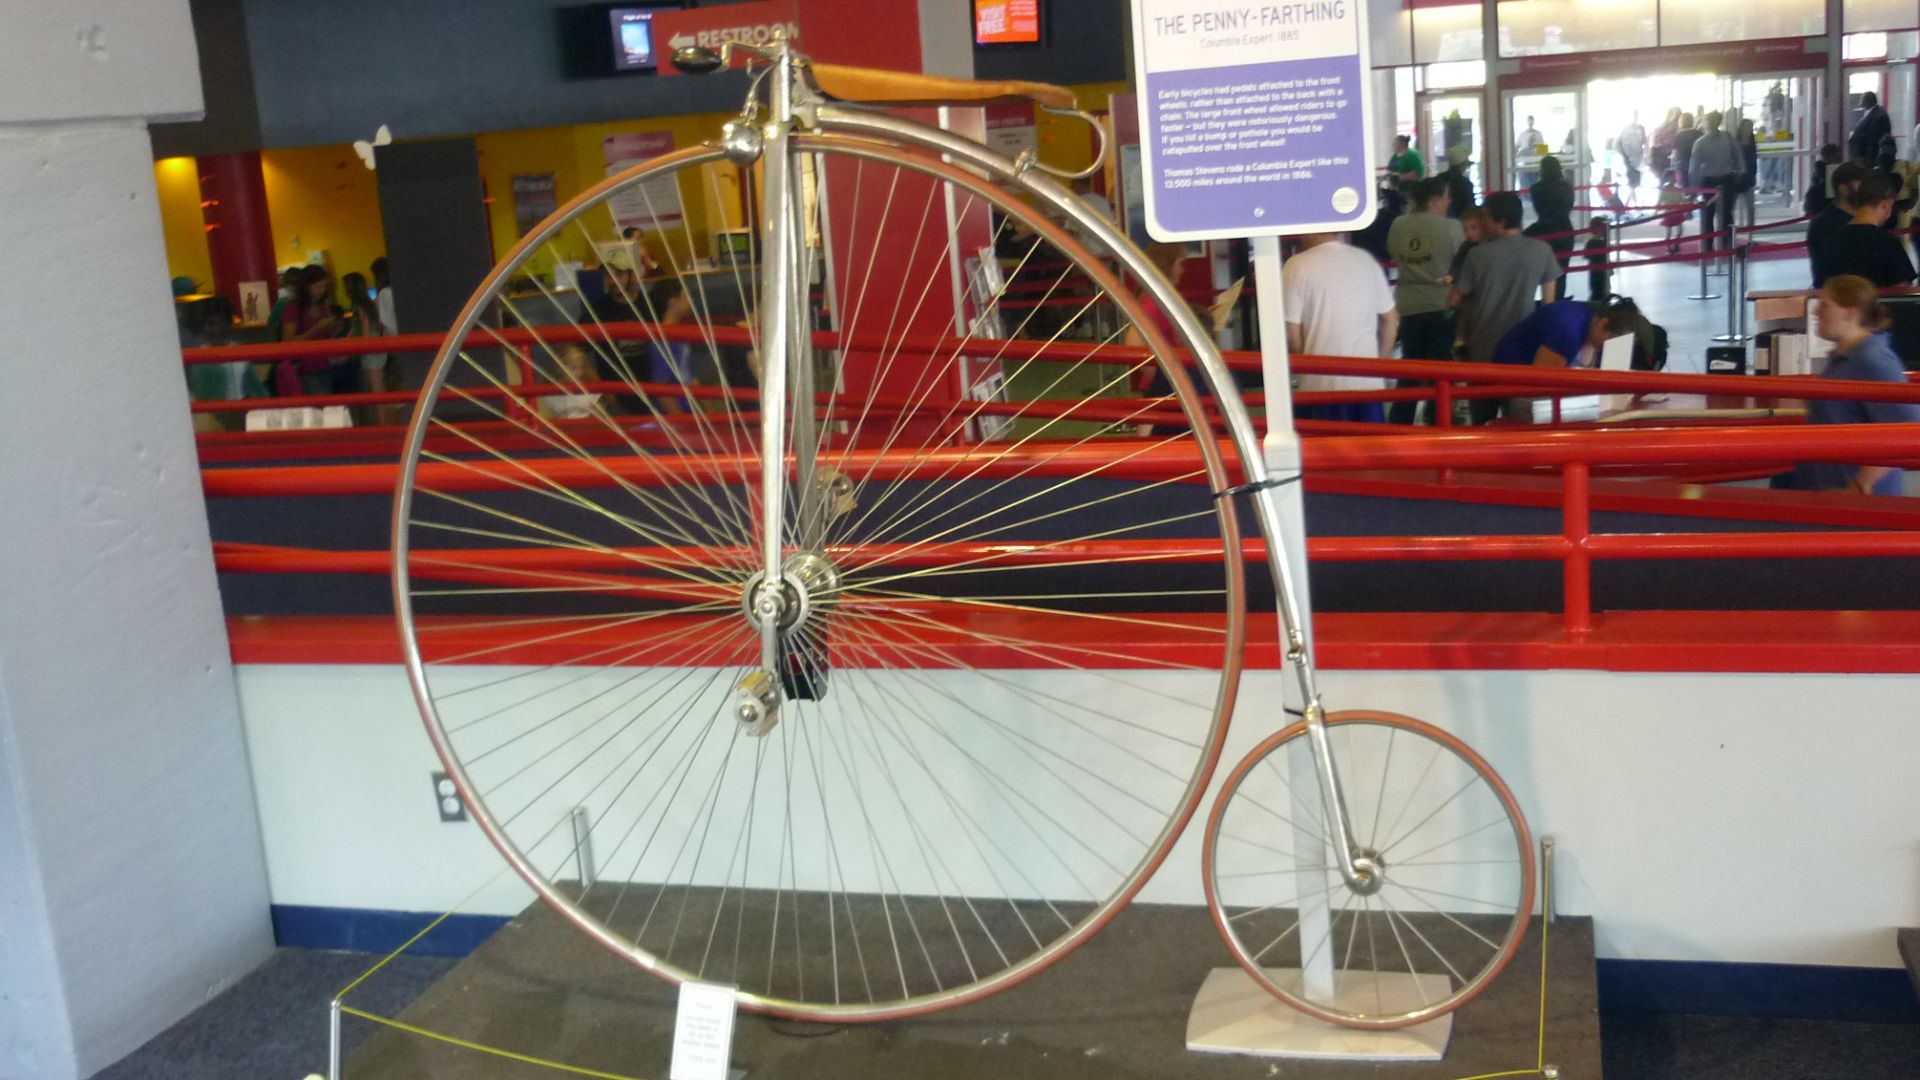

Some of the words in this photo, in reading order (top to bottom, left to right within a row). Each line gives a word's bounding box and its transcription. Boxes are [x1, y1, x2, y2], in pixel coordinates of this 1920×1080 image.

[1154, 15, 1186, 36] THE
[1192, 0, 1345, 32] PENNY-FARTHING
[1200, 36, 1240, 49] Columbia
[1278, 29, 1299, 42] 1885
[1158, 90, 1179, 100] Early
[1181, 87, 1213, 99] bicycles
[1214, 85, 1230, 95] had
[1230, 83, 1257, 95] pedals
[1258, 80, 1293, 91] attached
[1295, 79, 1304, 88] to
[1305, 78, 1319, 87] the
[1320, 76, 1341, 85] front
[1189, 97, 1214, 108] rather
[1215, 97, 1234, 106] than
[1235, 94, 1270, 104] attached
[1271, 93, 1281, 101] to
[1281, 91, 1295, 100] the
[1295, 90, 1316, 99] back
[1317, 88, 1336, 97] with
[1337, 88, 1343, 96] a
[1185, 111, 1199, 120] The
[1200, 110, 1222, 120] large
[1222, 107, 1242, 117] front
[1243, 104, 1268, 114] wheel
[1269, 103, 1299, 113] allowed
[1300, 101, 1324, 110] riders
[1325, 100, 1335, 108] to
[1336, 99, 1348, 109] go
[1160, 124, 1184, 133] faster
[1192, 121, 1206, 130] but
[1206, 121, 1226, 130] they
[1227, 119, 1248, 127] were
[1248, 115, 1293, 126] notoriously
[1169, 135, 1184, 146] you
[1204, 132, 1227, 141] bump
[1269, 127, 1286, 138] you
[1287, 125, 1311, 135] would
[1311, 124, 1323, 133] be
[1162, 144, 1204, 156] catapulted
[1204, 143, 1223, 152] over
[1224, 142, 1238, 151] the
[1239, 140, 1259, 150] front
[1164, 168, 1194, 178] Thomas
[1194, 166, 1226, 175] Stevens
[1226, 164, 1245, 173] rode
[1251, 161, 1288, 171] Columbia
[1289, 159, 1316, 169] Expert
[1317, 157, 1332, 166] like
[1332, 156, 1350, 165] this
[1192, 177, 1214, 187] miles
[1215, 175, 1243, 185] around
[1243, 175, 1257, 184] the
[1258, 172, 1281, 182] world
